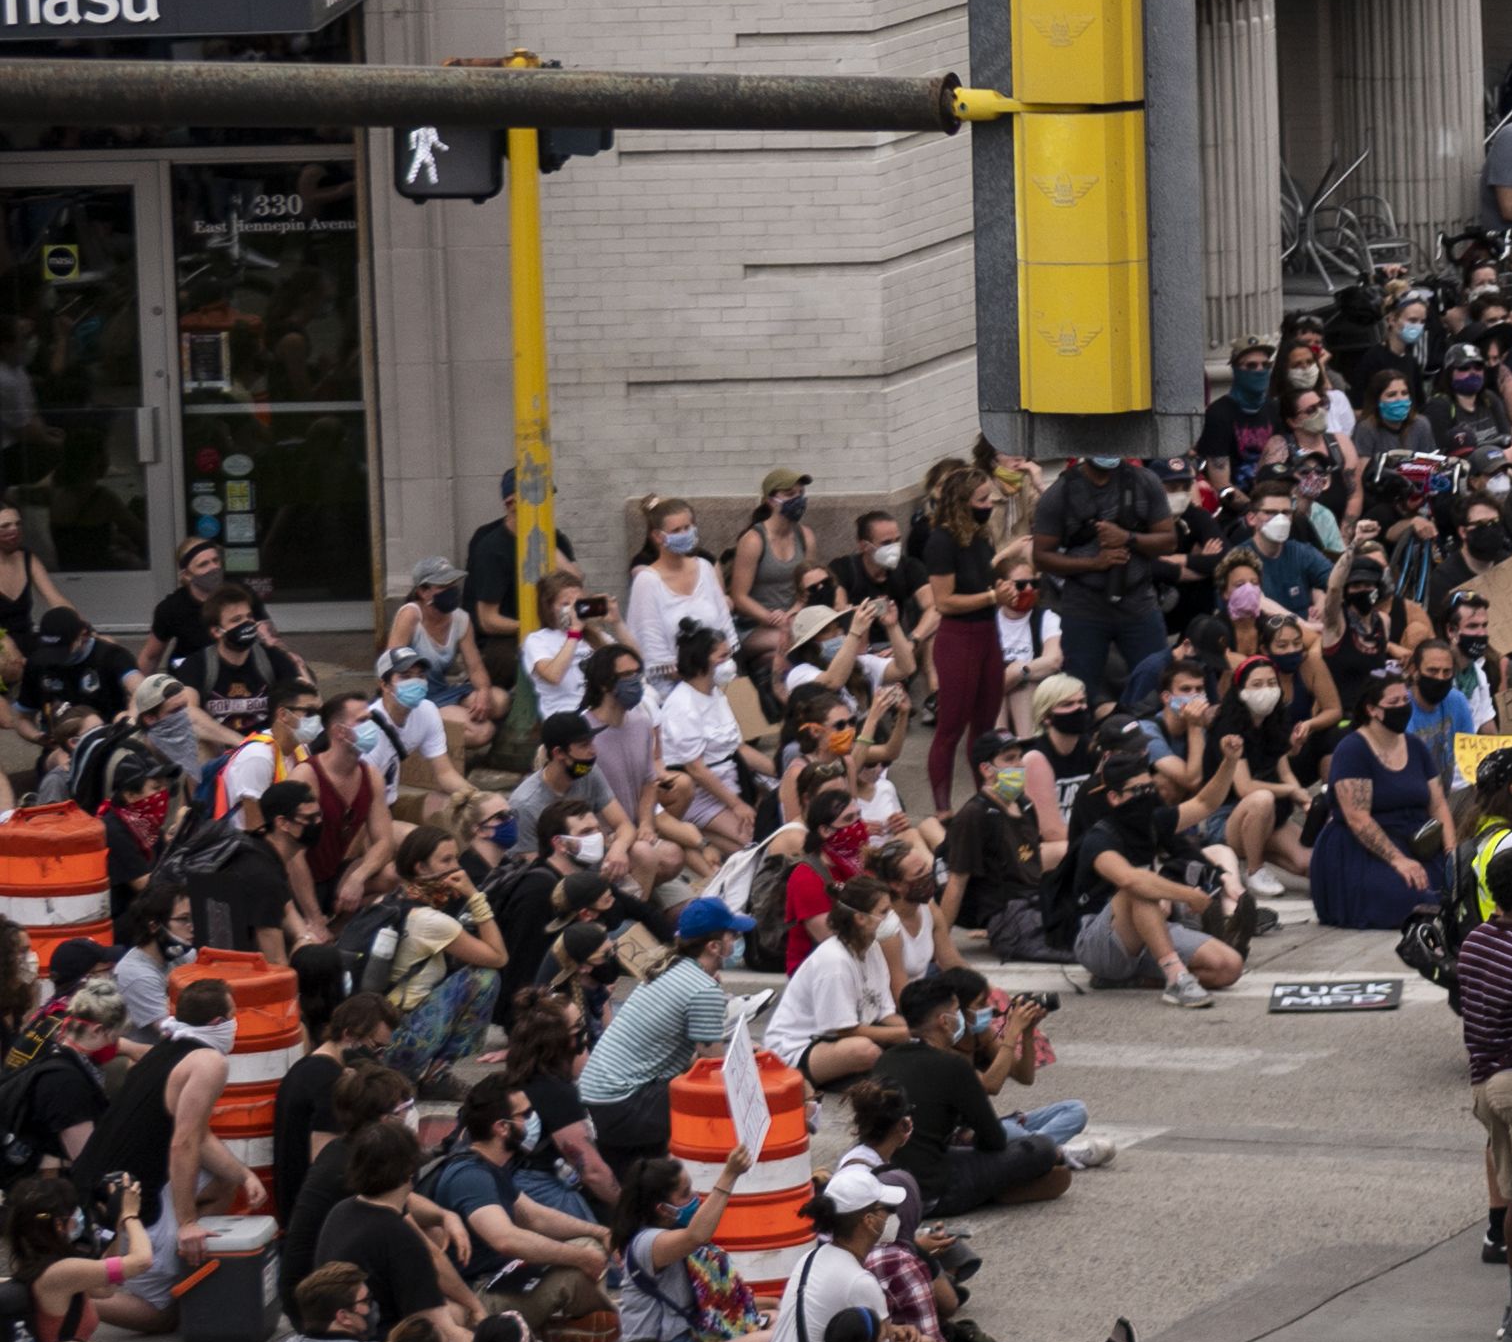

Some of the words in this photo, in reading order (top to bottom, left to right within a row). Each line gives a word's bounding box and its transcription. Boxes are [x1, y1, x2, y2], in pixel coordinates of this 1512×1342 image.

[254, 194, 300, 216] 330
[190, 219, 224, 233] East
[228, 217, 303, 235] Hennepin
[306, 217, 357, 233] Avenu
[1274, 981, 1393, 997] FUCK
[1281, 994, 1388, 1007] MPD
